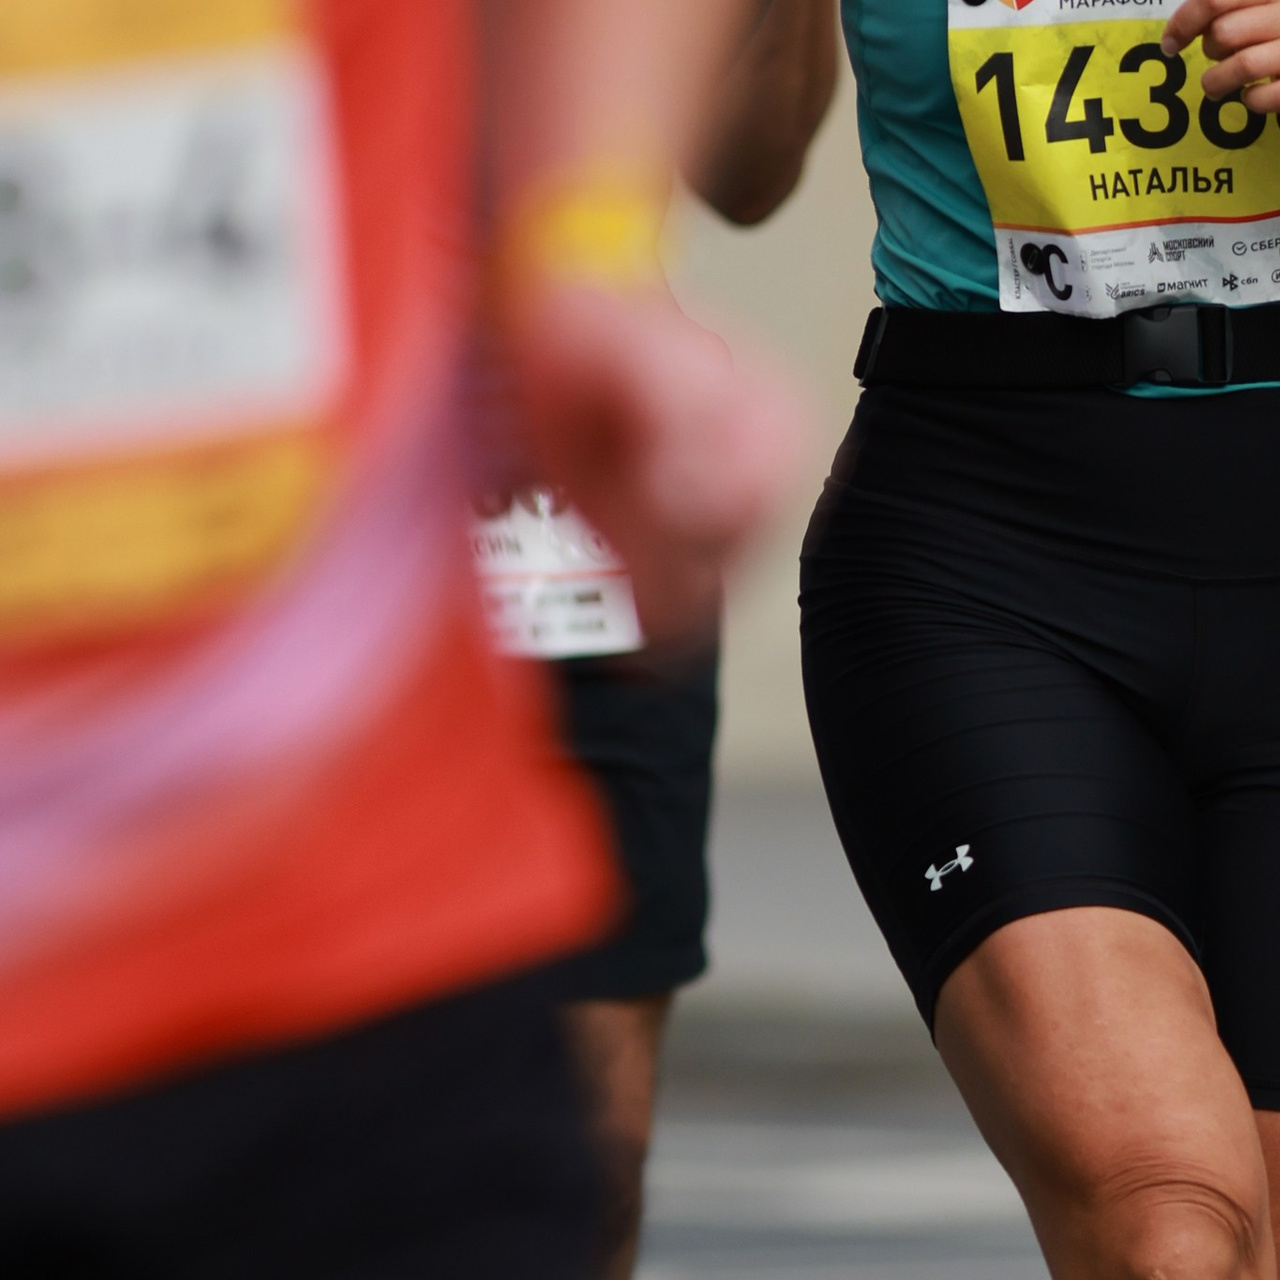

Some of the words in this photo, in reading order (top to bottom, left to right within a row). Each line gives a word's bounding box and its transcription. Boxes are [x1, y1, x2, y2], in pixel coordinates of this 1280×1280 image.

[1089, 166, 1234, 202] НАТАЛЬЯ
[1162, 235, 1215, 251] МОСКОВСКИЙ
[1163, 250, 1187, 263] СПОРТ
